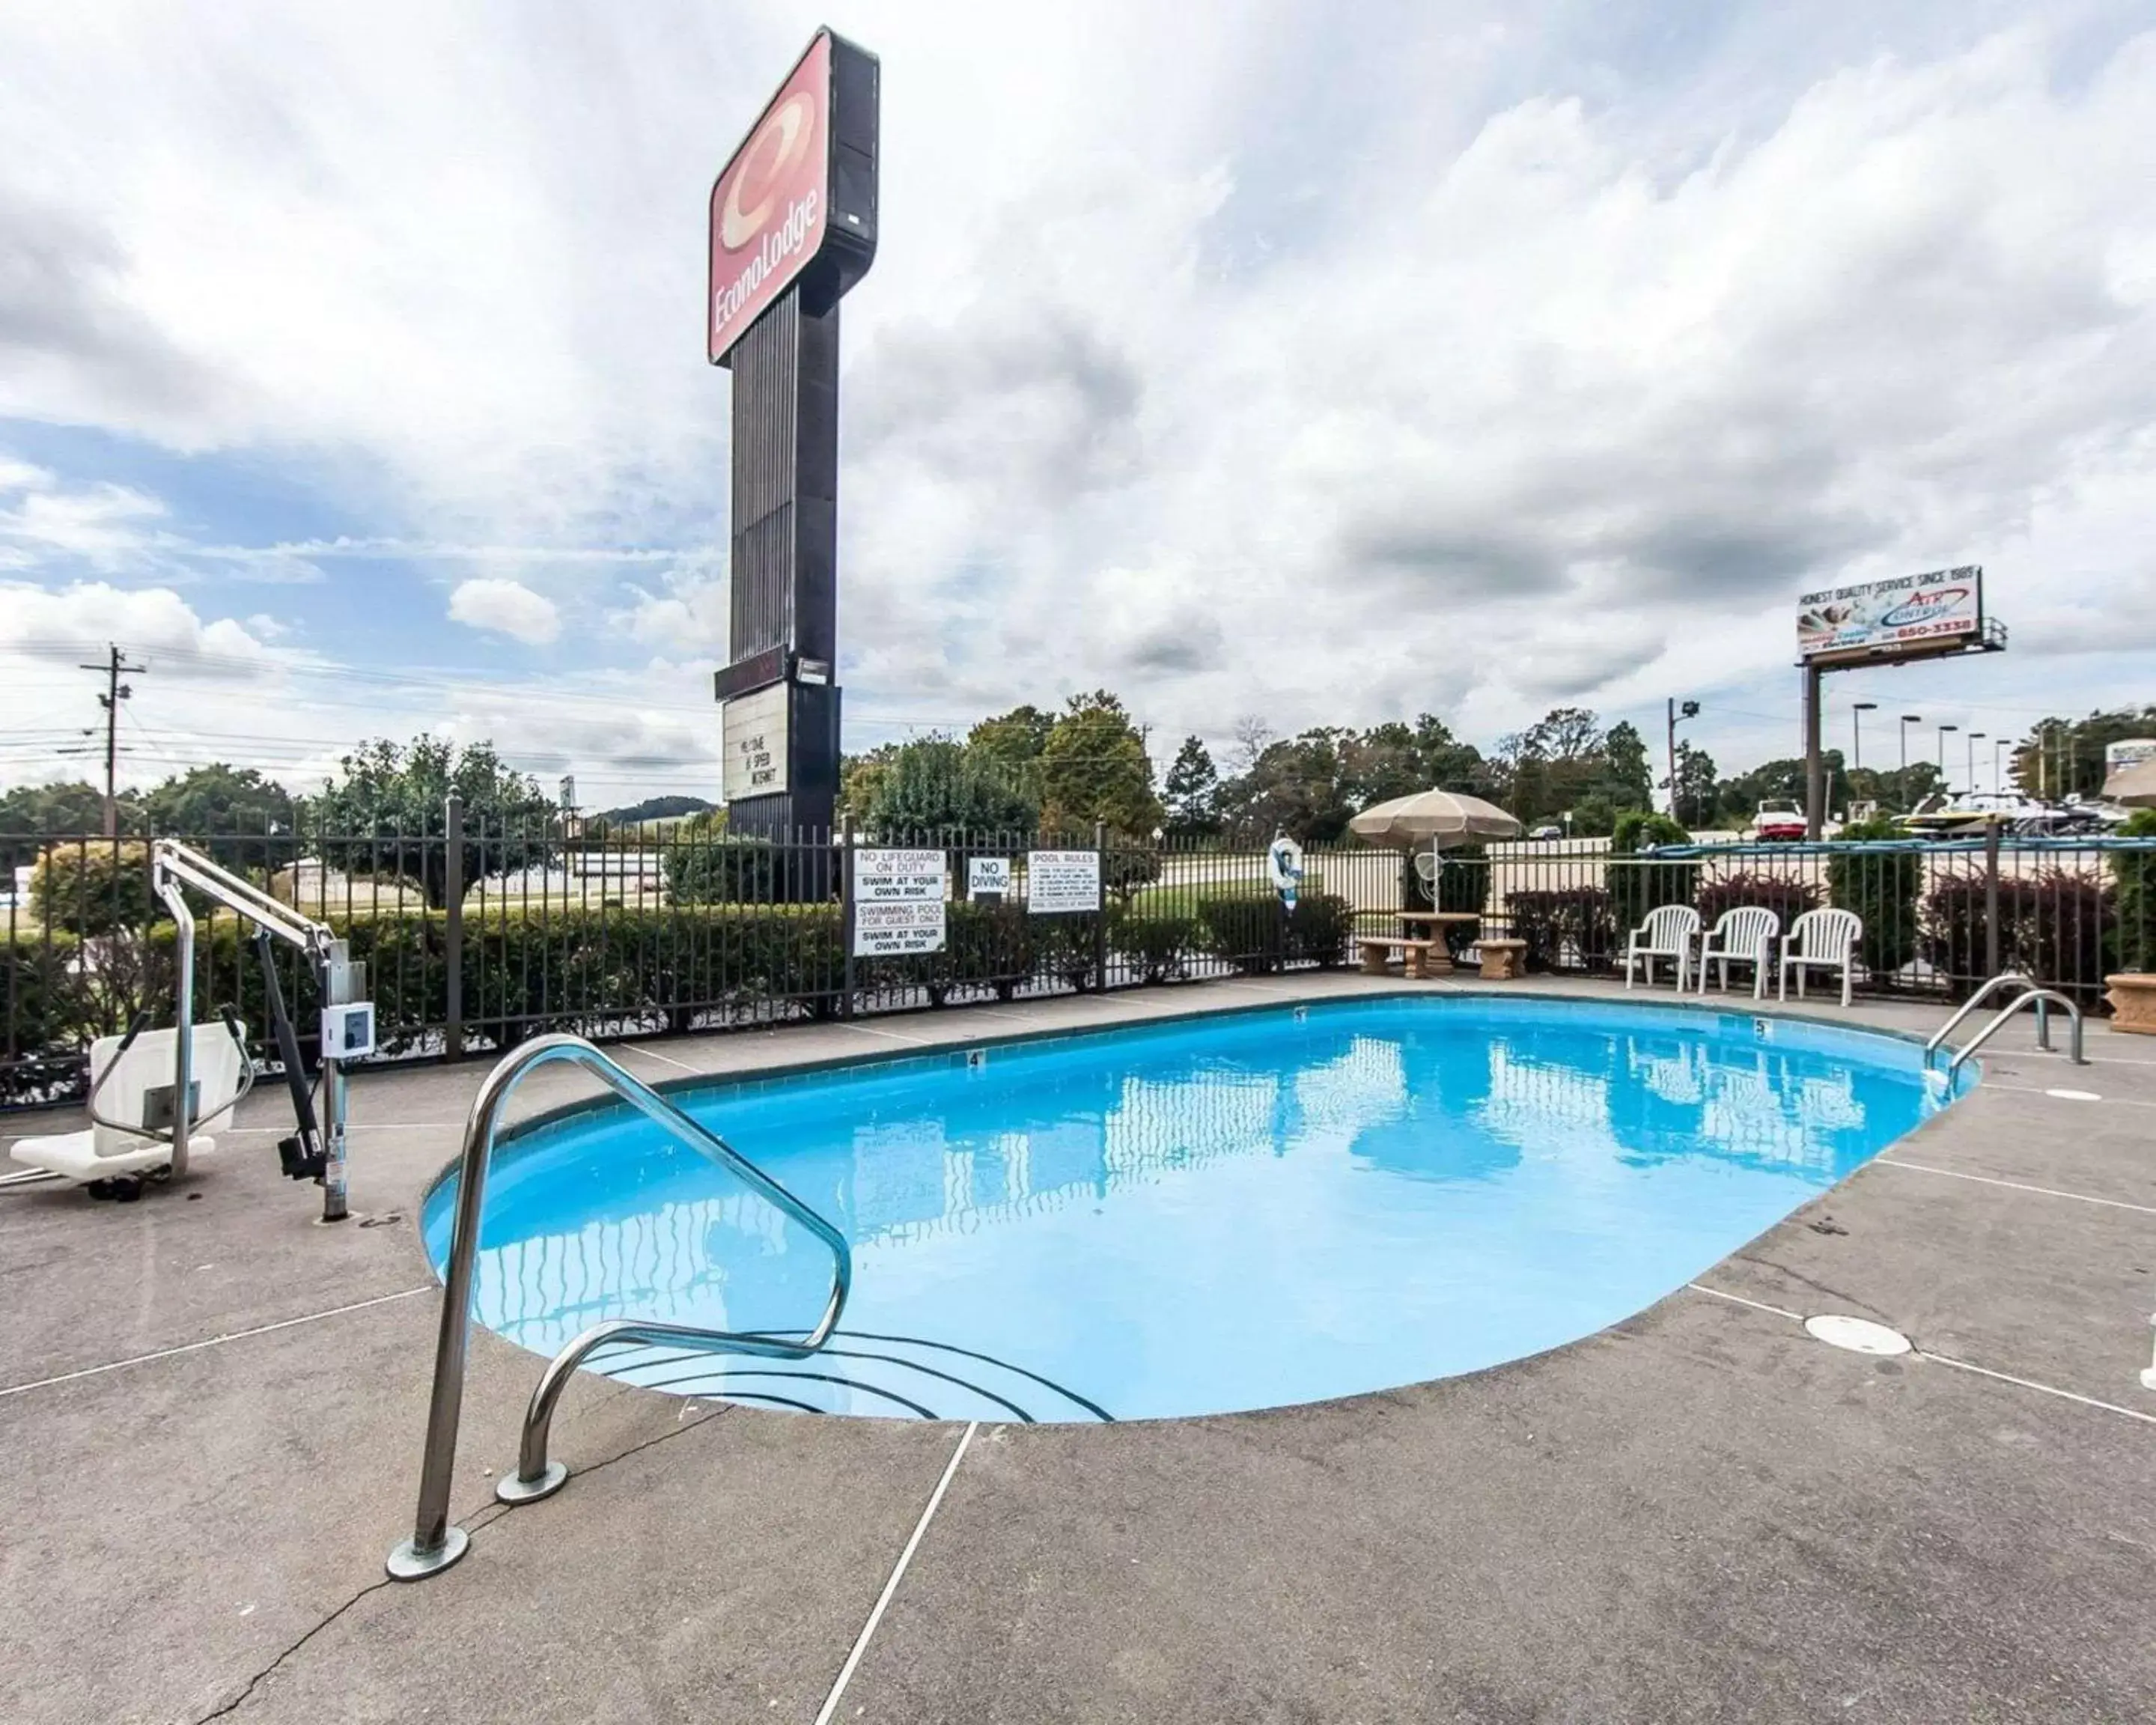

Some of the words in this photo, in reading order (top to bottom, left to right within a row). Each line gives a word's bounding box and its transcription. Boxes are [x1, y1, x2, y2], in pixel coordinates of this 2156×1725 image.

[1800, 589, 1833, 605] HONEST
[1836, 584, 1872, 600] QUALITY
[1875, 576, 1913, 597] SERVICE
[1918, 570, 1945, 586] SINCE
[861, 852, 876, 862] NO
[883, 852, 940, 862] LIFEGUARD
[1035, 854, 1059, 863] POOL
[1065, 854, 1093, 863] RULES
[876, 862, 892, 873] ON
[898, 862, 925, 872] DUTY
[981, 862, 999, 874] NO
[862, 877, 892, 886] SWIM
[897, 877, 908, 885] AT
[913, 876, 938, 885] YOUR
[972, 874, 1008, 887] DIVING
[874, 887, 901, 896] OWN
[904, 887, 926, 895] RISK
[859, 905, 913, 916] SWIMMING
[918, 904, 941, 914] POOL
[862, 915, 881, 925] FOR
[886, 914, 915, 925] GUEST
[919, 914, 940, 923] ONLY
[862, 931, 892, 941] SWIM
[897, 930, 908, 938] AT
[913, 929, 938, 937] YOUR
[874, 941, 901, 950] OWN
[904, 940, 927, 948] RISK
[969, 1053, 978, 1065] 4
